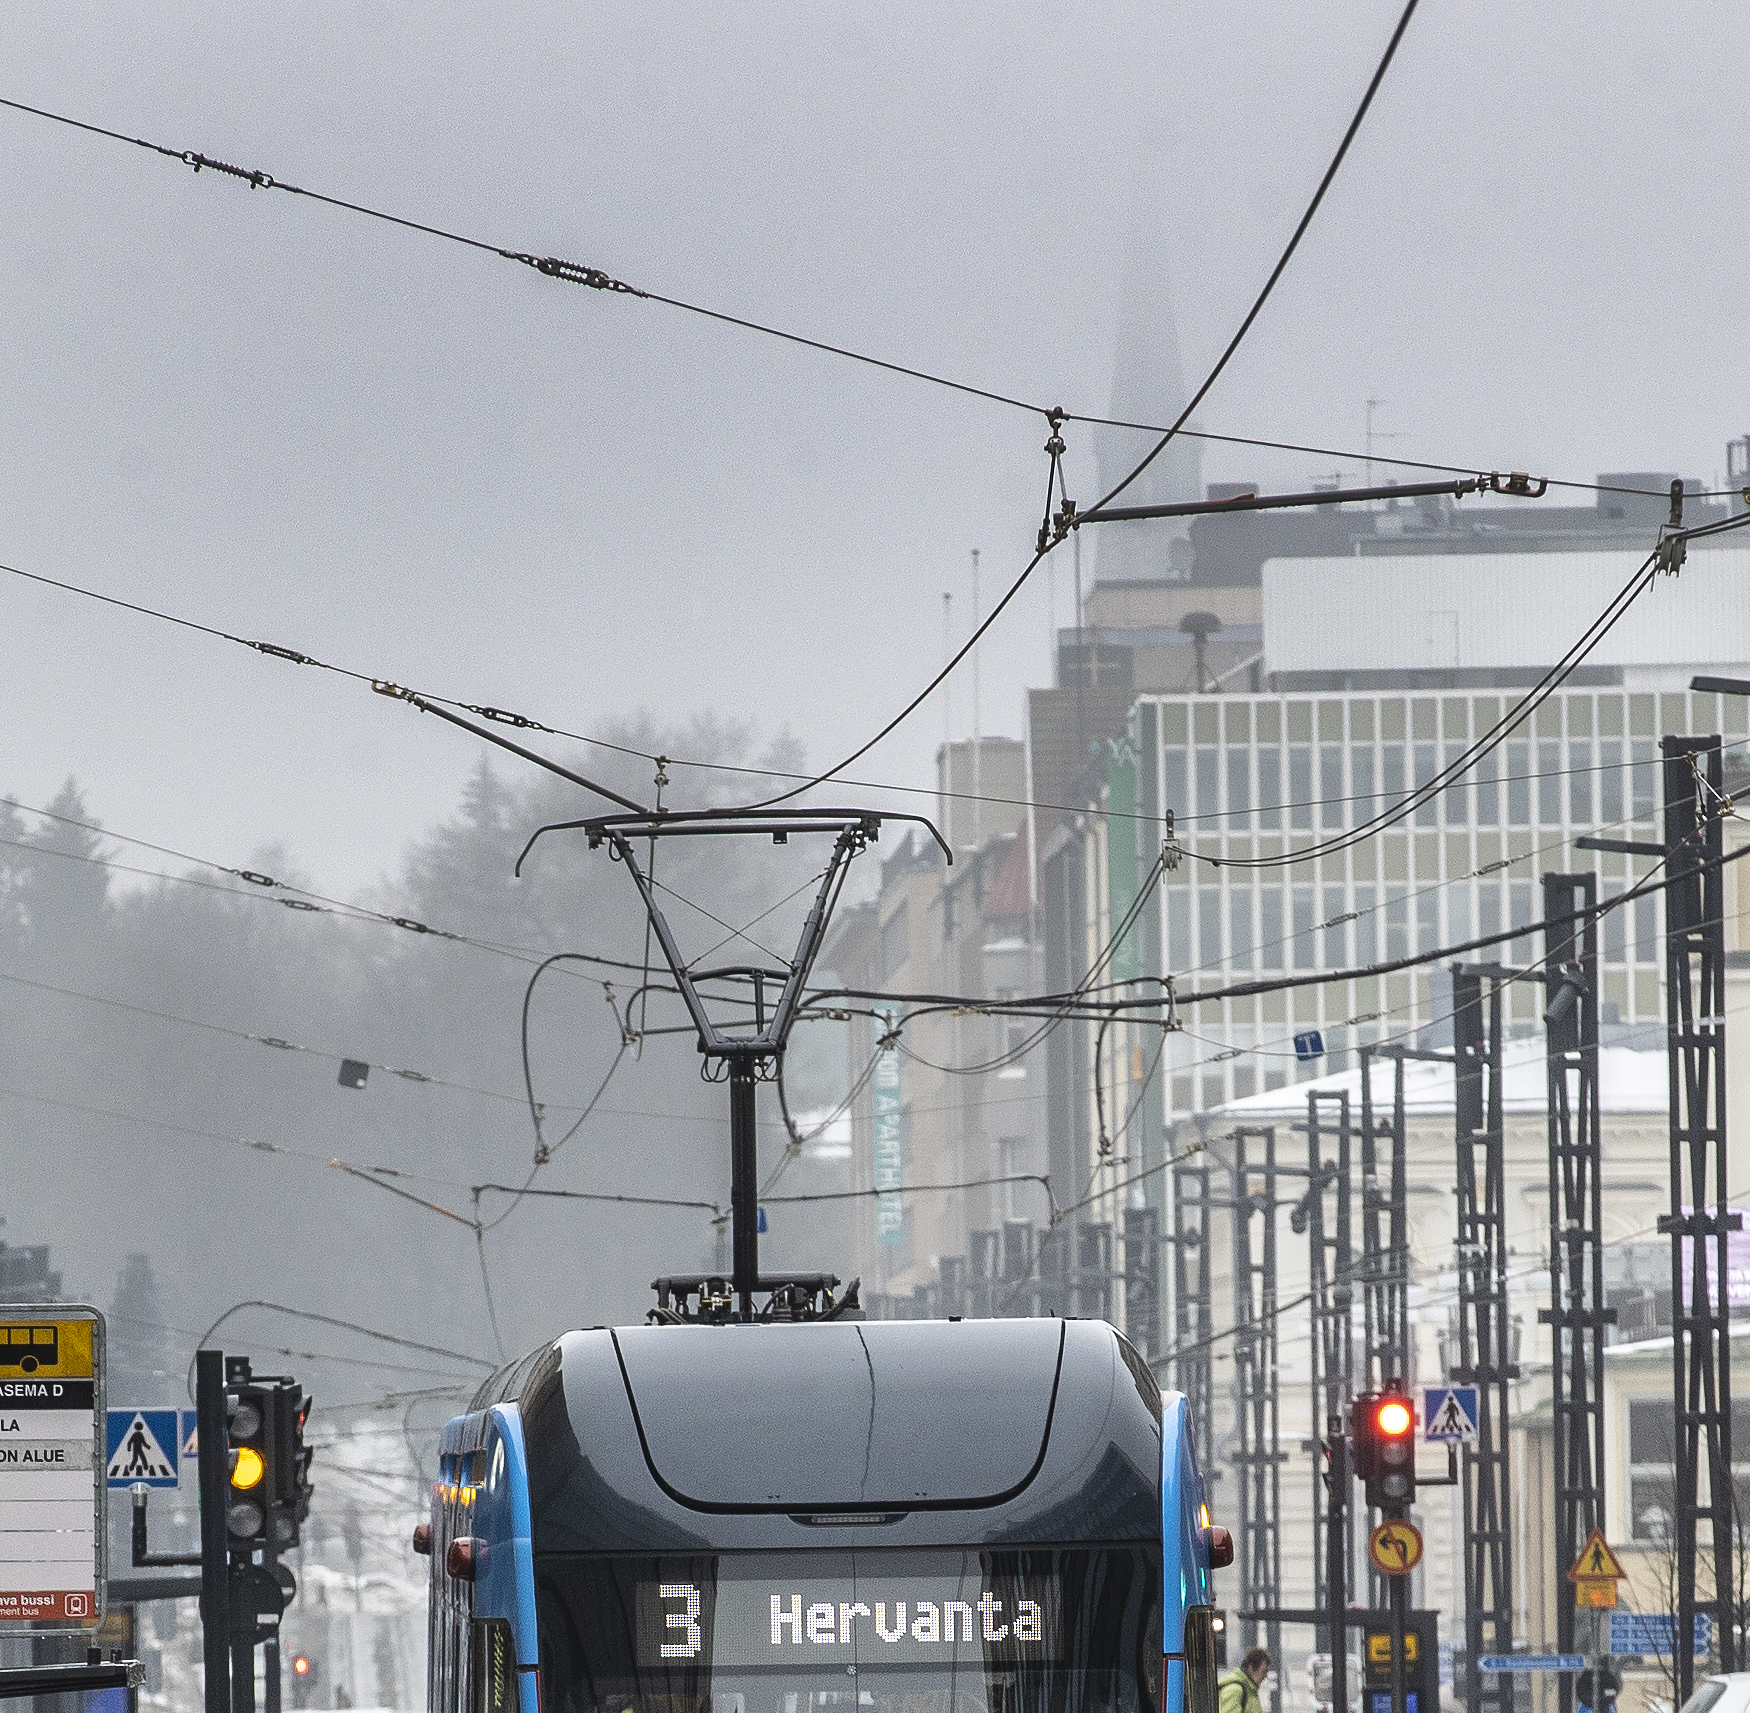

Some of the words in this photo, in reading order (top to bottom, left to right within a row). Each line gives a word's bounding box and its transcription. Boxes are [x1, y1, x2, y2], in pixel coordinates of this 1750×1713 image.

[875, 1096, 903, 1236] APARTHOTEL
[53, 1385, 63, 1397] D
[23, 1449, 65, 1463] ALUE
[20, 1594, 55, 1605] bussi
[23, 1607, 39, 1616] bus
[659, 1584, 701, 1658] 3
[769, 1591, 1042, 1645] Hervanta
